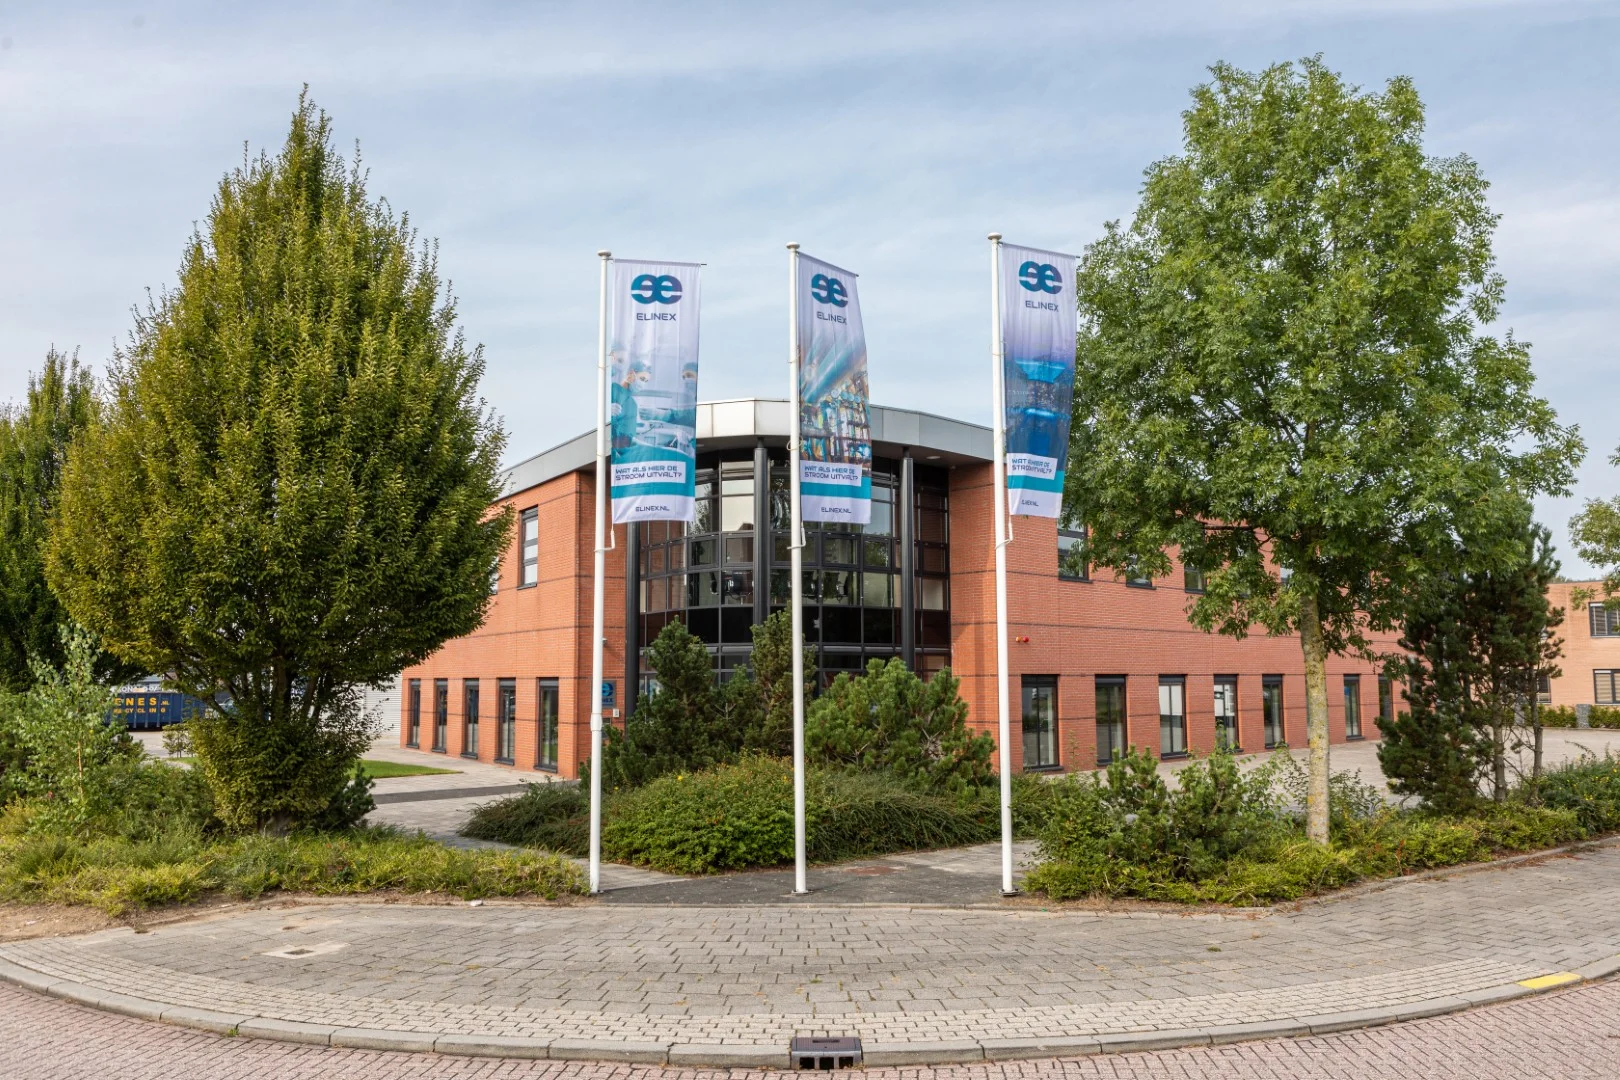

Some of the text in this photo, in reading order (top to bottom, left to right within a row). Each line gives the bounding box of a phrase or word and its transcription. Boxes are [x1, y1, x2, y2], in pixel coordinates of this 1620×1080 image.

[1025, 300, 1059, 312] ELINEX
[636, 313, 676, 321] ELINEX
[816, 311, 847, 325] ELINEX
